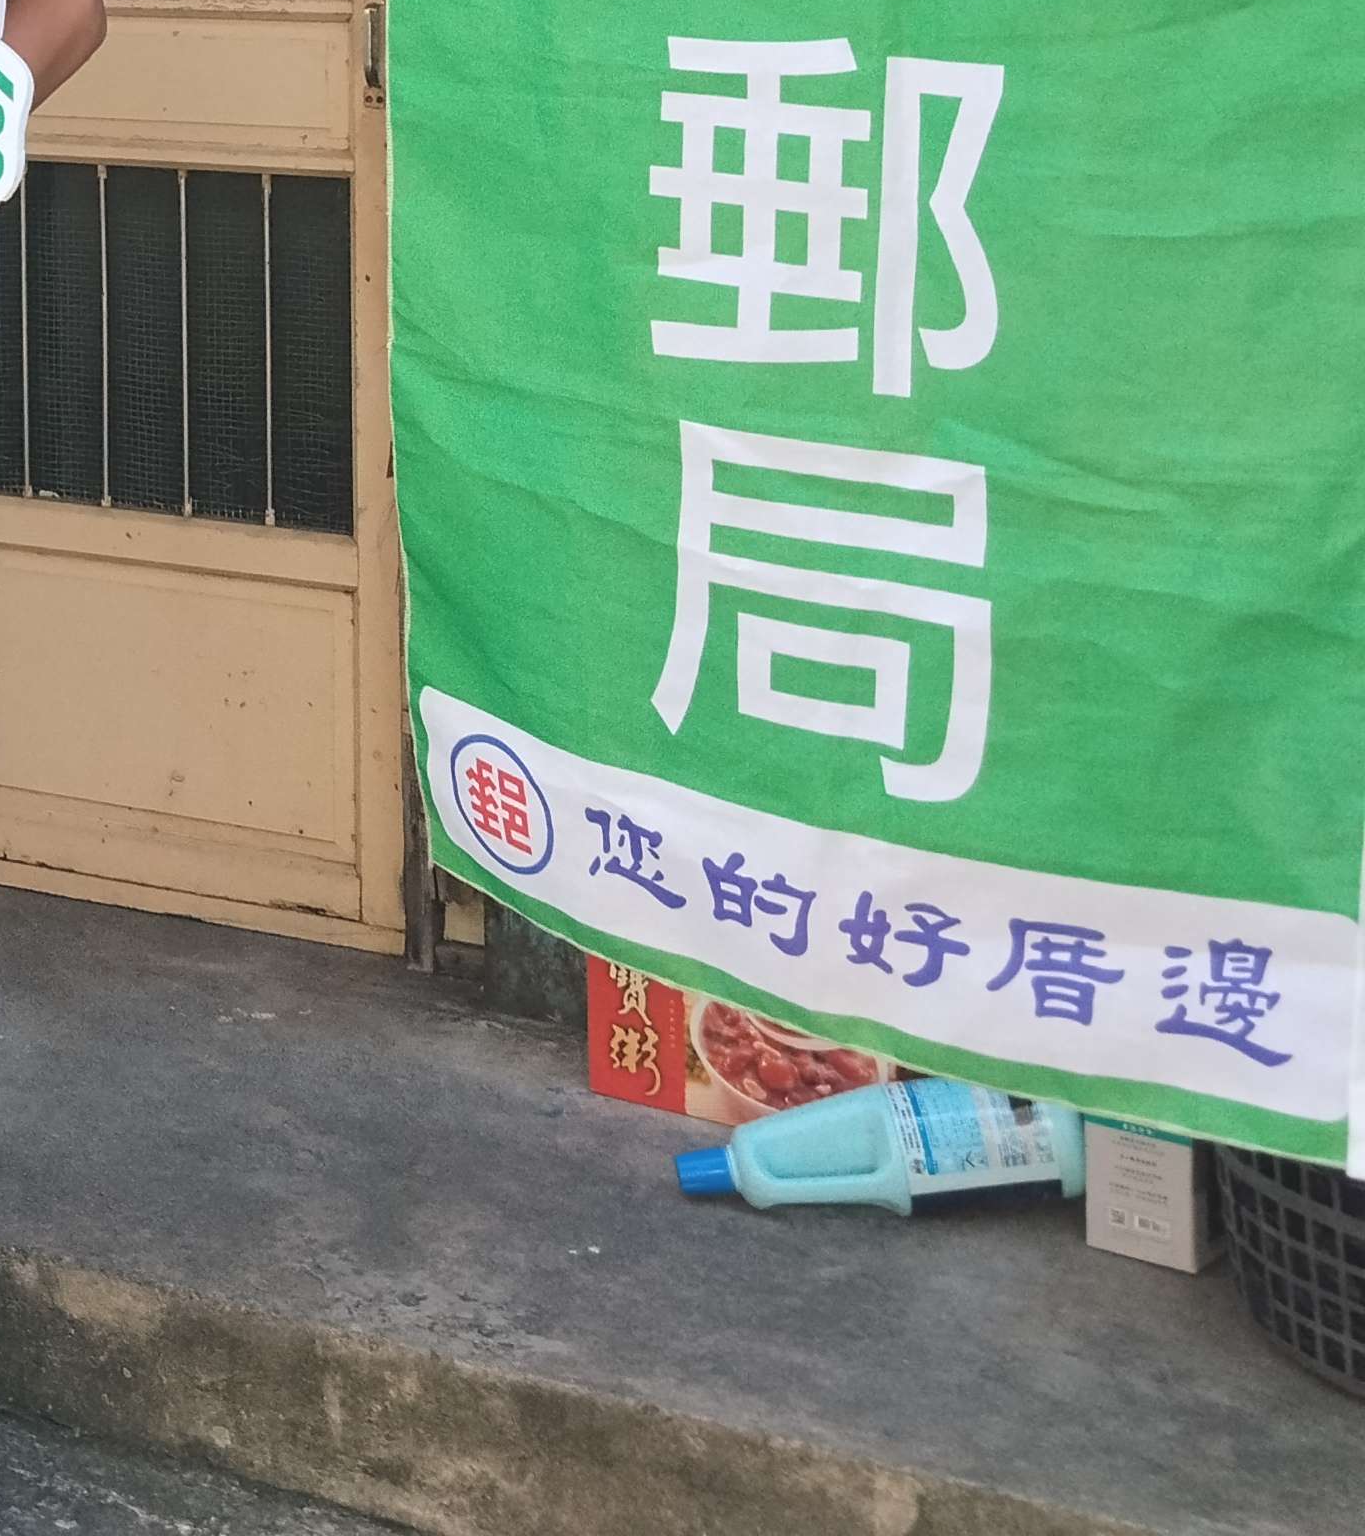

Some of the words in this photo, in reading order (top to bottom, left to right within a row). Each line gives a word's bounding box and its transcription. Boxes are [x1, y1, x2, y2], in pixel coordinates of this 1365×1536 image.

[584, 805, 1294, 1068] 您的好厝邊
